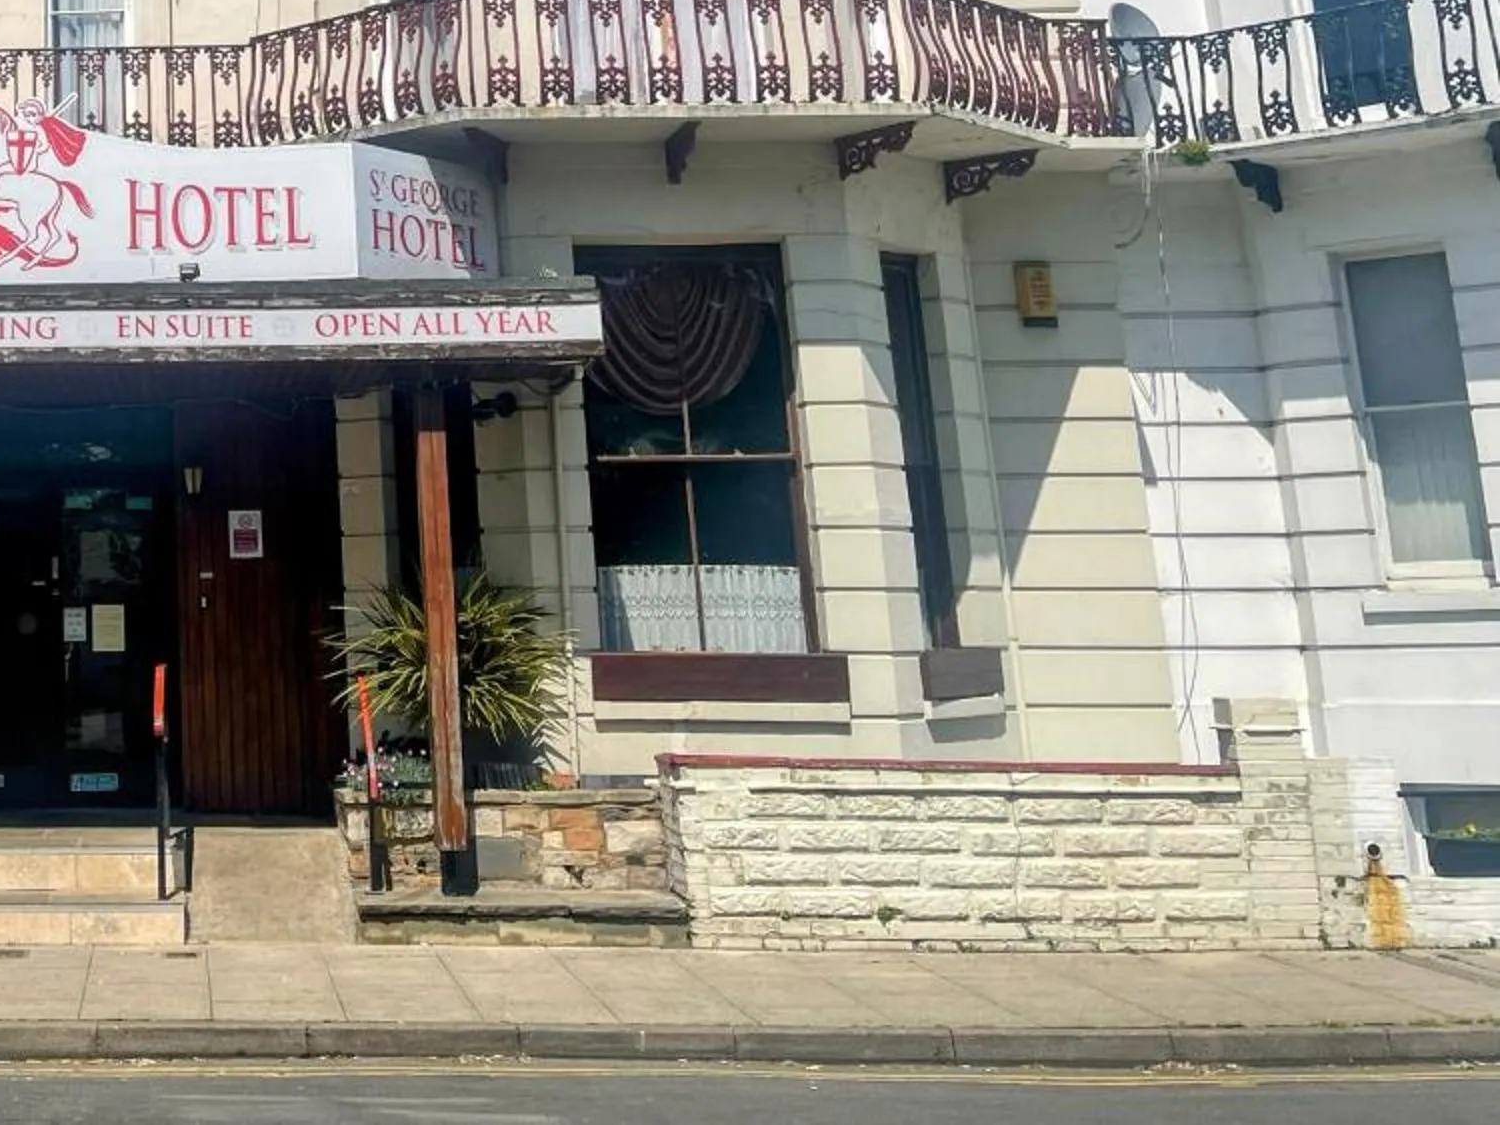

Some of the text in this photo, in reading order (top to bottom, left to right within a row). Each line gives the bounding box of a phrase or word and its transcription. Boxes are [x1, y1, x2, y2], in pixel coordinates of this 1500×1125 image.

[125, 177, 312, 251] HOTEL
[391, 174, 481, 218] GEORGE
[371, 208, 485, 268] HOTEL
[117, 314, 253, 339] EN SUITE
[315, 310, 558, 338] OPEN ALL YEAR
